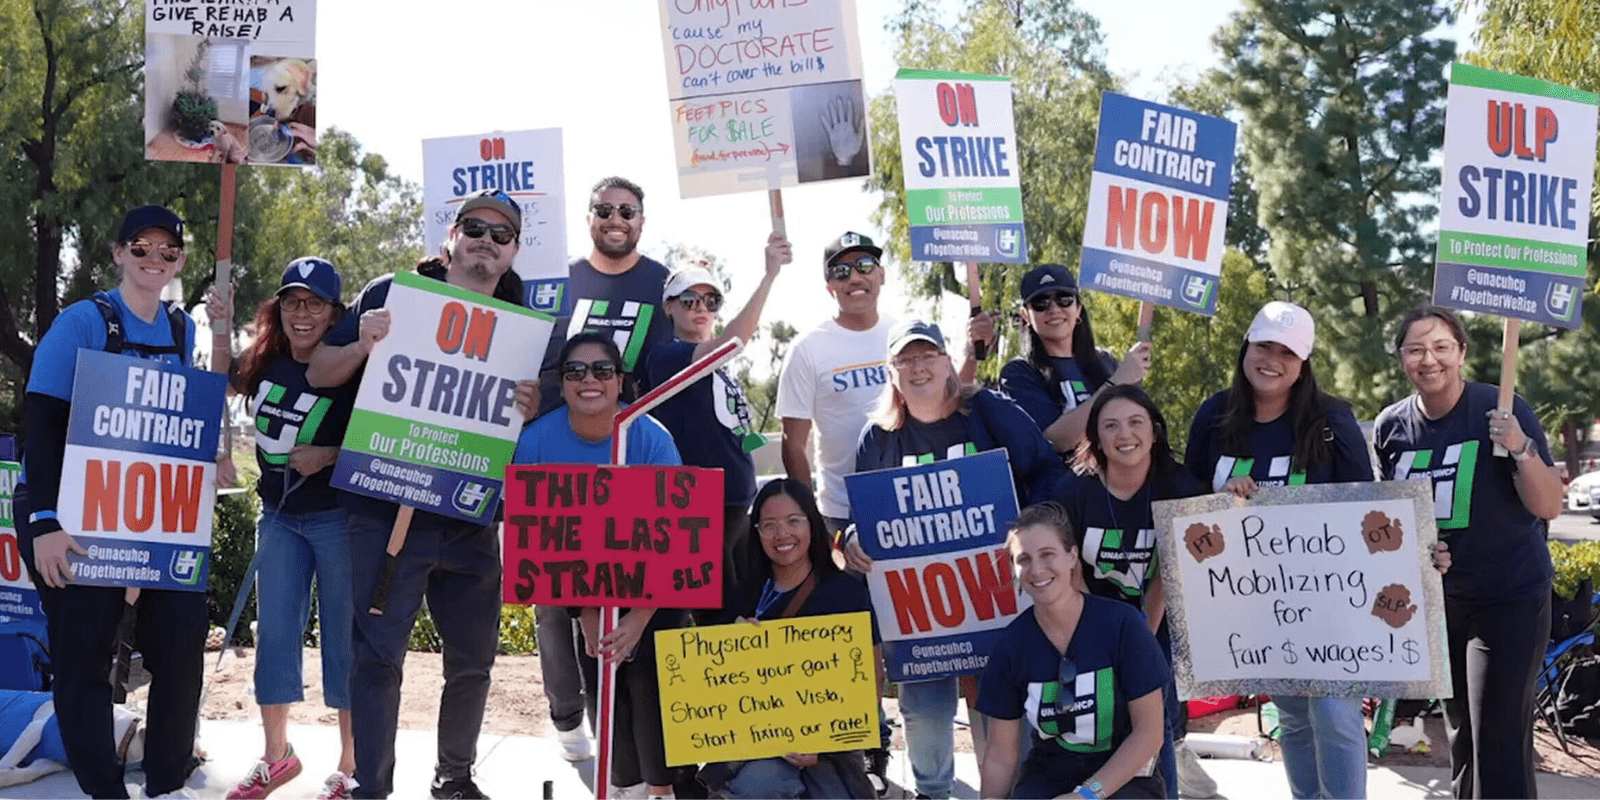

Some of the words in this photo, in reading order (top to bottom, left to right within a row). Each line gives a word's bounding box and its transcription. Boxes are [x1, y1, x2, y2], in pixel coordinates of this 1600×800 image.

[153, 7, 198, 21] GIVE
[206, 6, 268, 23] REHAB
[279, 6, 293, 22] A
[192, 21, 262, 40] RAISE!
[738, 19, 763, 39] my
[674, 28, 834, 75] DOCTORATE
[683, 72, 721, 88] can't
[726, 67, 759, 83] cover
[762, 63, 783, 78] the
[676, 103, 715, 124] FEET
[720, 99, 769, 117] PICS
[936, 82, 979, 127] ON
[688, 124, 719, 142] FOR
[1141, 108, 1198, 152] FAIR
[1487, 99, 1559, 163] ULP
[480, 137, 506, 162] ON
[915, 136, 1010, 178] STRIKE
[1114, 139, 1216, 187] CONTRACT
[453, 161, 535, 196] STRIKE
[926, 205, 946, 221] Our
[947, 204, 1010, 220] Professions
[1458, 164, 1577, 230] STRIKE
[1105, 184, 1216, 262] NOW
[924, 242, 990, 257] #TogetherWeRise
[1450, 238, 1462, 254] To
[1464, 239, 1502, 258] Protect
[1504, 243, 1522, 260] Our
[1523, 245, 1578, 268] Professions
[1094, 272, 1173, 300] #TogetherWeRise
[1109, 258, 1163, 282] @unacuhcp
[1467, 268, 1526, 293] @unacuhcp
[1451, 286, 1537, 314] #TogetherWeRise
[435, 300, 498, 362] ON
[125, 366, 187, 412] FAIR
[382, 354, 517, 427] STRIKE
[833, 365, 886, 392] STRI
[93, 405, 205, 450] CONTRACT
[409, 423, 420, 437] To
[420, 425, 460, 446] Protect
[369, 431, 398, 452] Our
[401, 437, 490, 473] Professions
[350, 471, 442, 508] #TogetherWeRise
[369, 458, 433, 488] @unacuhcp
[515, 467, 613, 508] THIS
[655, 470, 697, 510] IS
[82, 459, 204, 534] NOW
[893, 469, 963, 514] FAIR
[508, 514, 582, 552] THE
[604, 515, 711, 554] LAST
[876, 503, 997, 550] CONTRACT
[1192, 532, 1213, 554] PT
[1240, 515, 1345, 558] Rehab
[1368, 523, 1394, 544] OT
[70, 561, 161, 582] #TogetherWeRise
[87, 544, 150, 564] @unacuhcp
[513, 558, 653, 602] STRAW.
[672, 560, 714, 592] SLP
[884, 548, 1019, 636] NOW
[1208, 563, 1367, 608] Mobilizing
[1273, 599, 1312, 626] for
[1377, 595, 1405, 612] SLP
[680, 630, 769, 666] Physical
[778, 624, 853, 644] Therapy
[911, 640, 973, 659] @unacuhcp
[1228, 632, 1272, 668] fair
[1281, 638, 1298, 665] $
[1305, 632, 1395, 674] wages!
[1401, 637, 1421, 665] $
[703, 667, 750, 688] fixes
[756, 662, 796, 685] your
[801, 652, 840, 677] gait
[670, 701, 727, 724] Sharp
[738, 695, 785, 714] Chula
[796, 688, 844, 706] Vista,
[690, 729, 737, 749] Start
[749, 723, 795, 744] fixing
[800, 722, 823, 737] our
[830, 712, 869, 732] rate!
